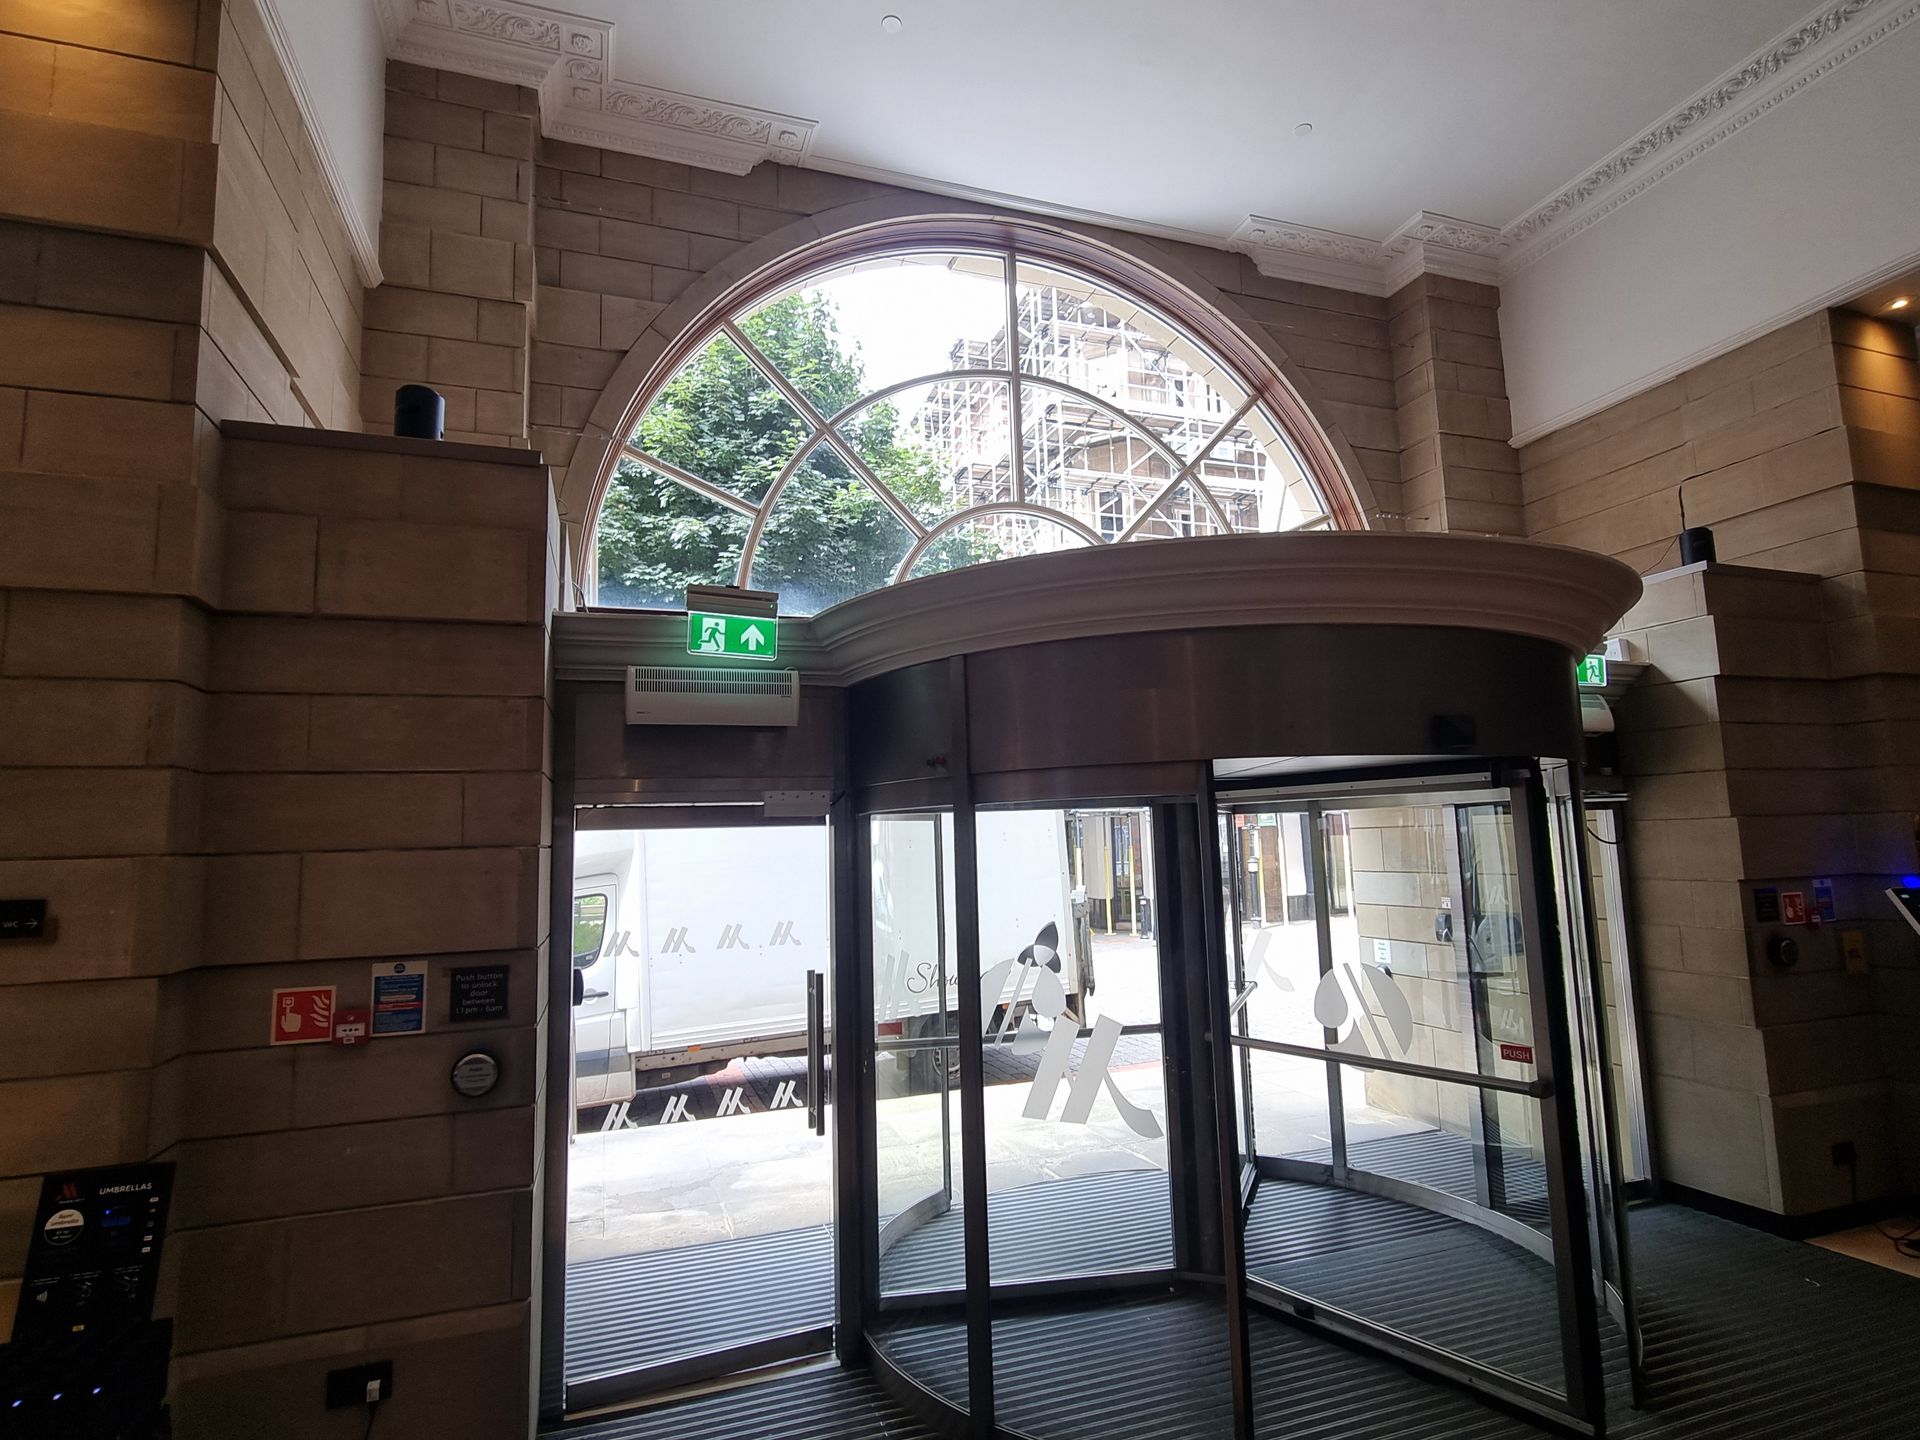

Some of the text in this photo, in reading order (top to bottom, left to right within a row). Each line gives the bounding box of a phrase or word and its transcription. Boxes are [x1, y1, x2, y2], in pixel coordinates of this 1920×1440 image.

[456, 974, 475, 982] Push
[472, 981, 497, 989] unlock
[463, 998, 496, 1006] between
[1503, 1049, 1530, 1060] PUSH
[99, 1182, 153, 1195] UMBRELLAS
